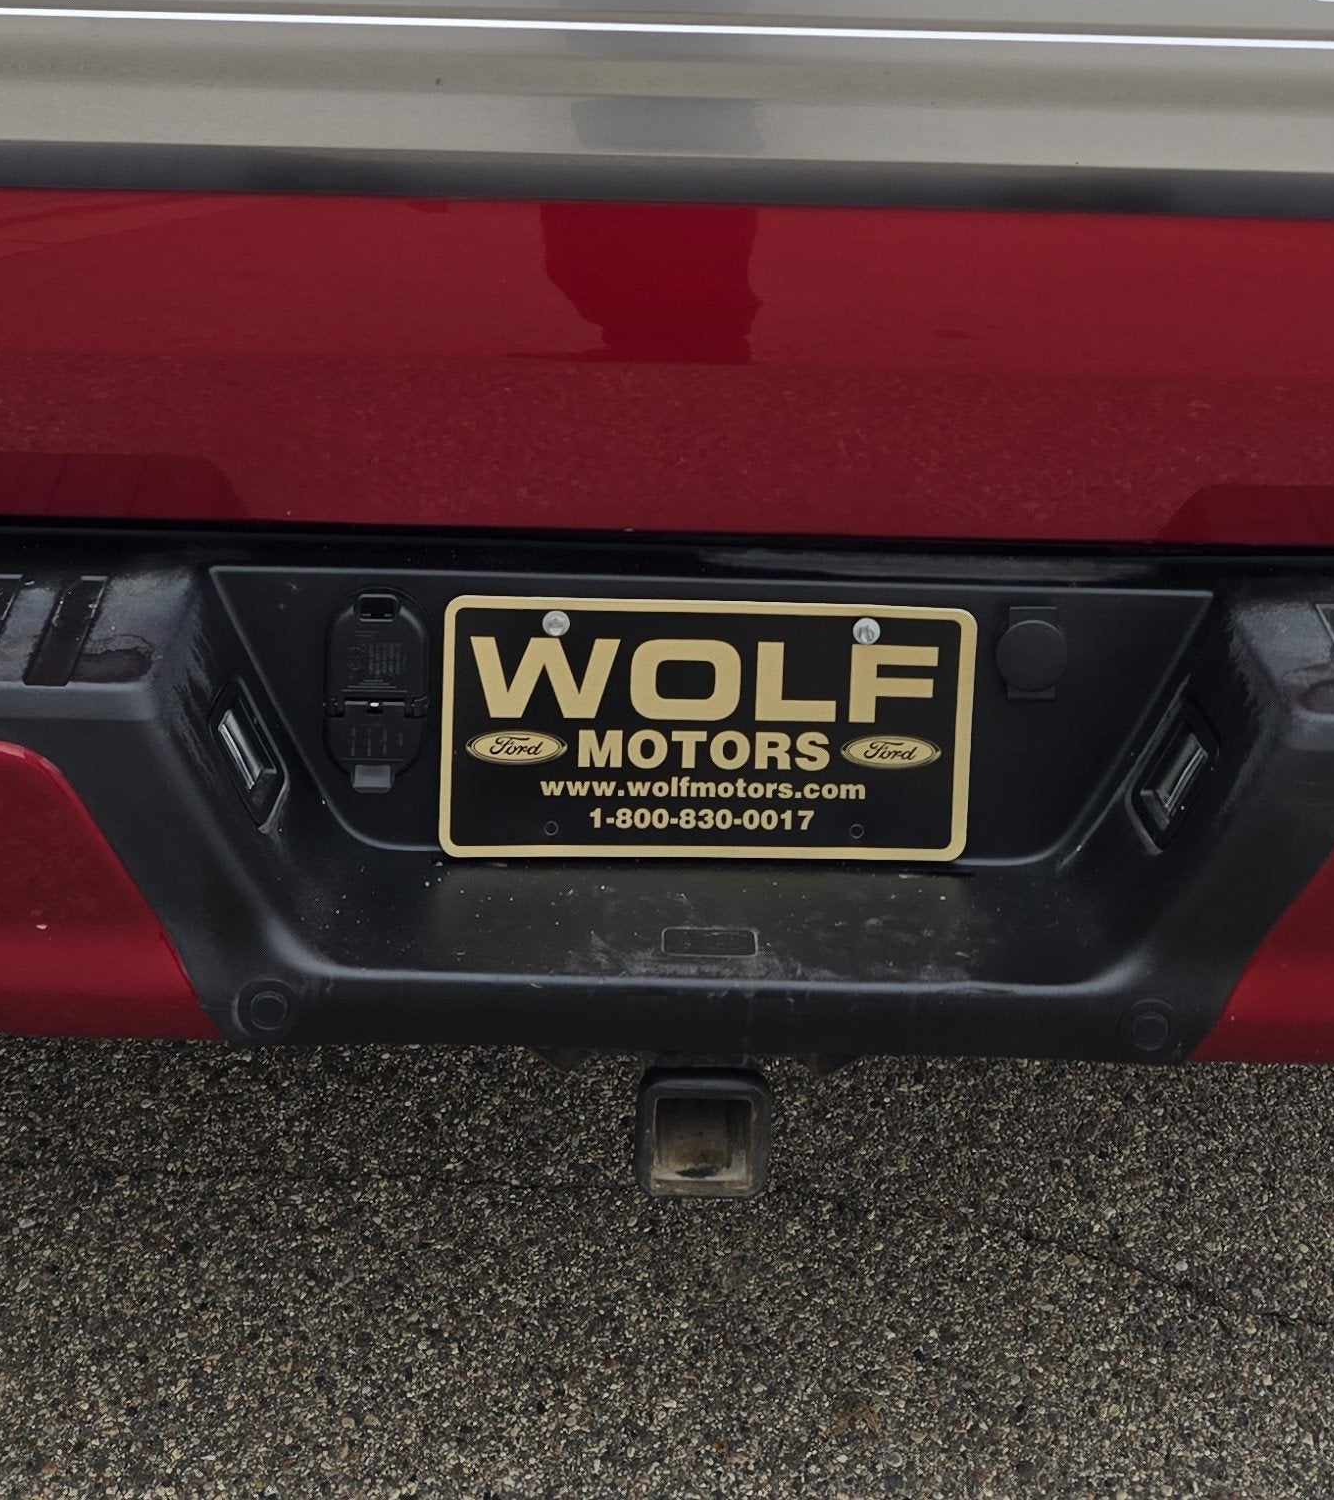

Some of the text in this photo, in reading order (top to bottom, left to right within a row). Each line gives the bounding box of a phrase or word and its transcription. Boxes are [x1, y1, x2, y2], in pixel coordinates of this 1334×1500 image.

[470, 635, 939, 723] WOLF
[578, 729, 831, 770] MOTORS
[540, 776, 866, 800] www.wolfmotors.com
[589, 807, 815, 831] 1-800-830-0017
